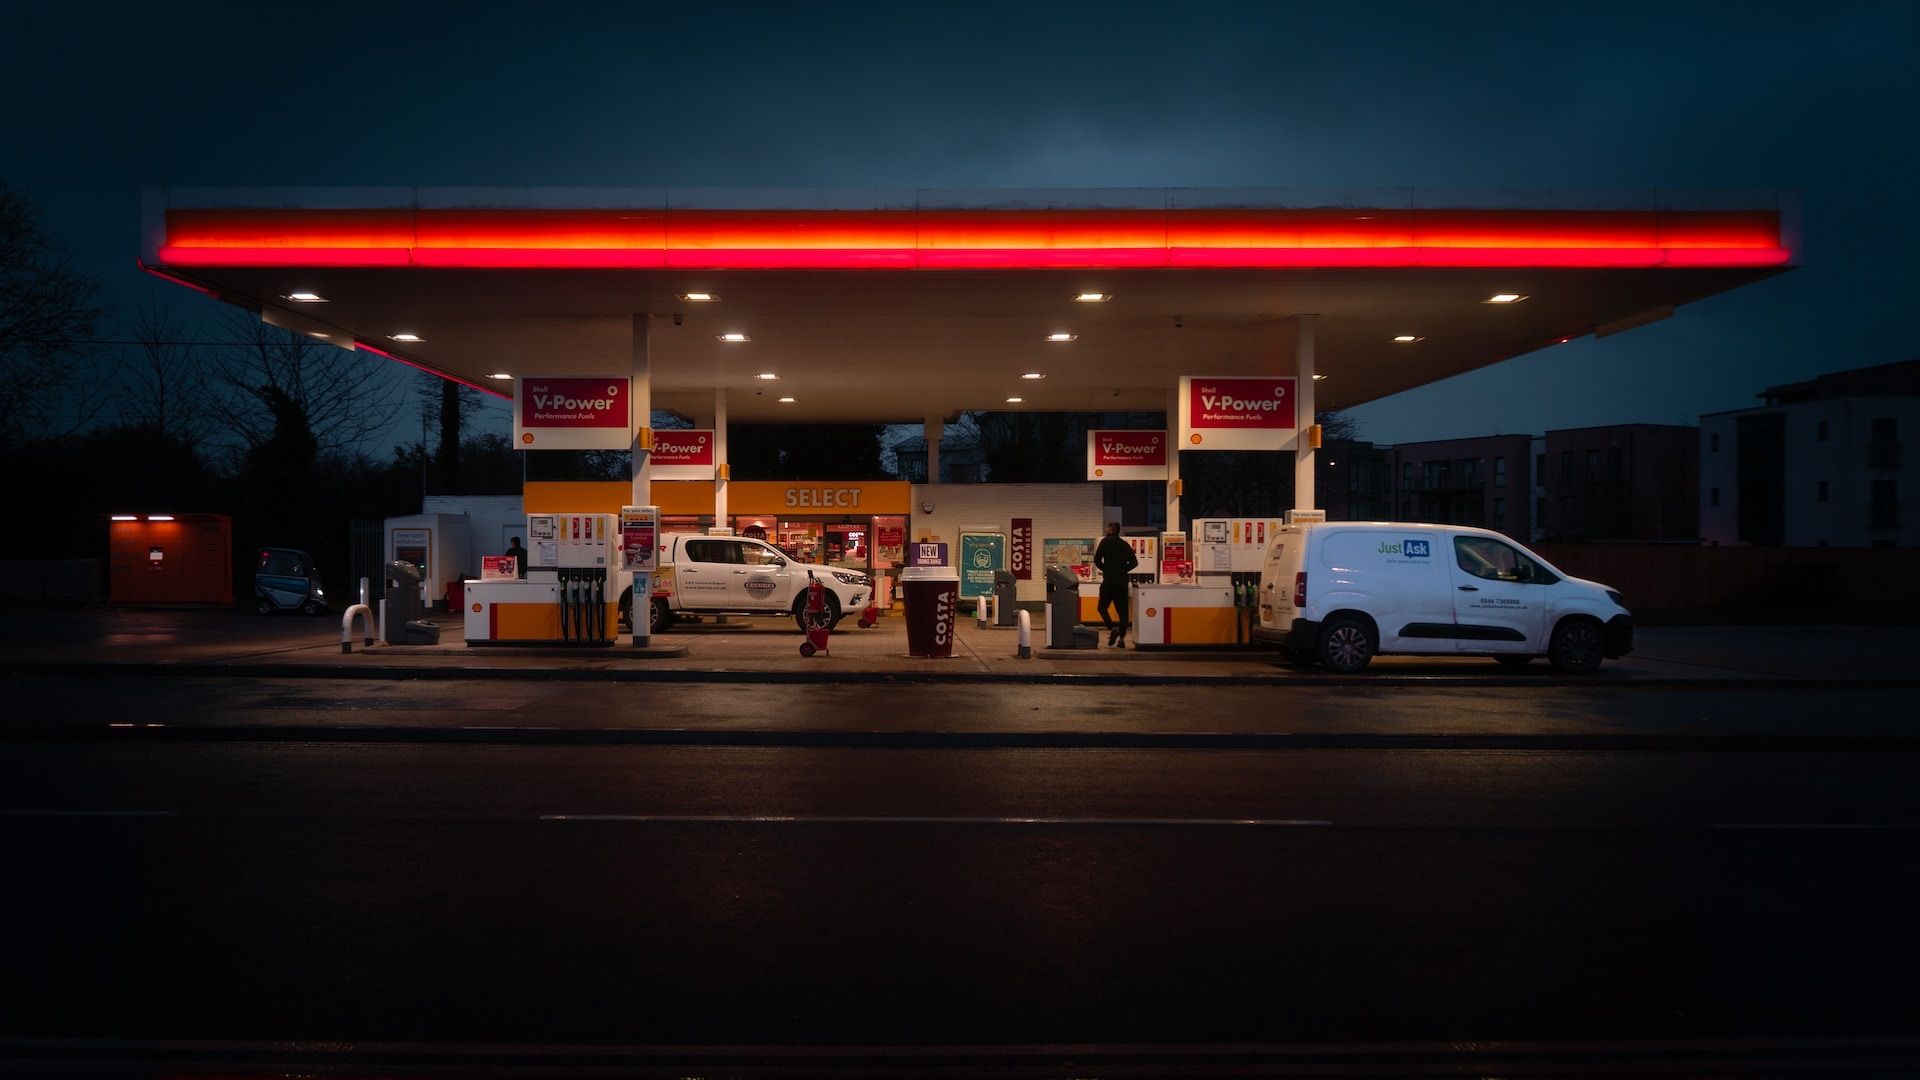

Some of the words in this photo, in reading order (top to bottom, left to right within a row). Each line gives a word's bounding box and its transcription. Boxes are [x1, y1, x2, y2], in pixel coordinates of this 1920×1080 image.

[532, 394, 615, 410] V-Power
[1201, 395, 1281, 411] V-Power
[1102, 443, 1157, 453] V-Power
[785, 488, 861, 508] SELECT
[921, 546, 937, 557] NEW
[1012, 527, 1024, 572] COSTA
[1378, 541, 1403, 554] Just
[1405, 541, 1427, 555] Ask
[935, 591, 950, 646] COSTA
